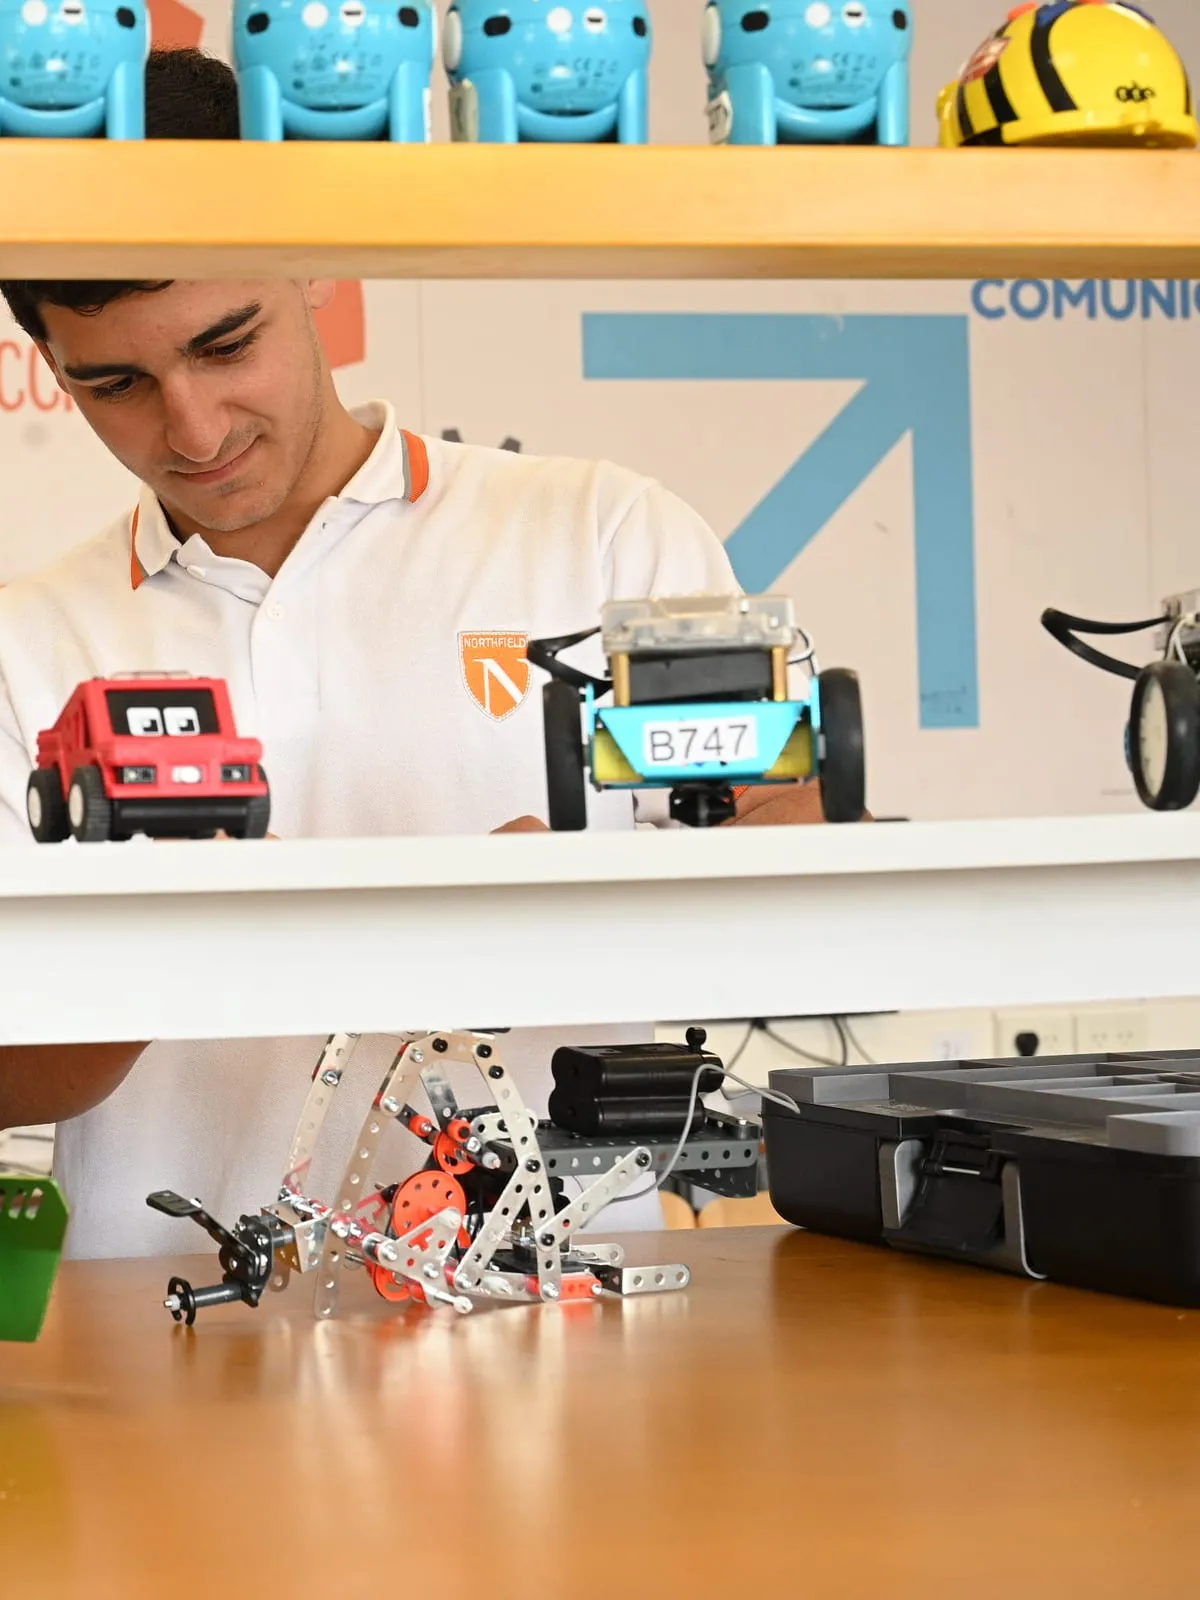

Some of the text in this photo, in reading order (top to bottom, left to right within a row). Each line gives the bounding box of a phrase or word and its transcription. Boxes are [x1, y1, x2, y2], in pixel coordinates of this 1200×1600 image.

[971, 279, 1200, 320] COMUNI
[463, 637, 527, 649] NORTHFIELD
[650, 724, 749, 762] B747
